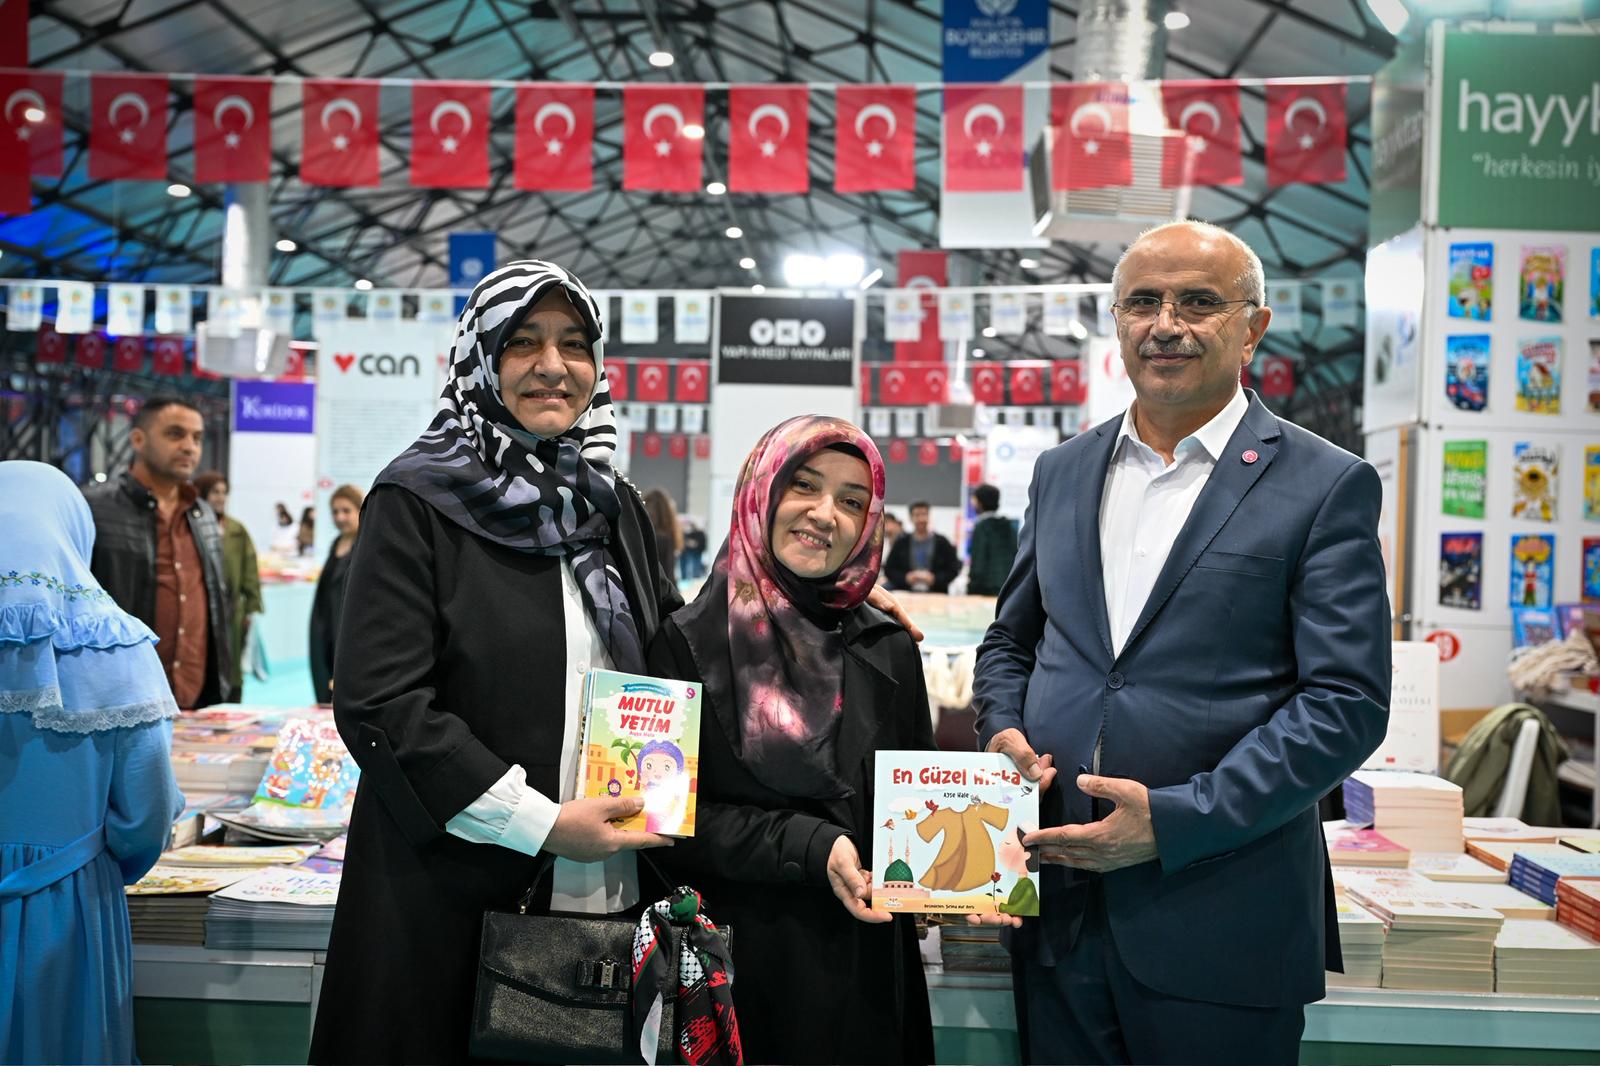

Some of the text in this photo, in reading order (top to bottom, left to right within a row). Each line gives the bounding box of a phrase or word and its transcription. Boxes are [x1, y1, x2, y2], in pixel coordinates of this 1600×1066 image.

[359, 354, 420, 377] can
[617, 695, 675, 715] MUTLU
[619, 713, 671, 733] YETİM
[893, 768, 912, 785] En
[919, 766, 967, 786] Güzel
